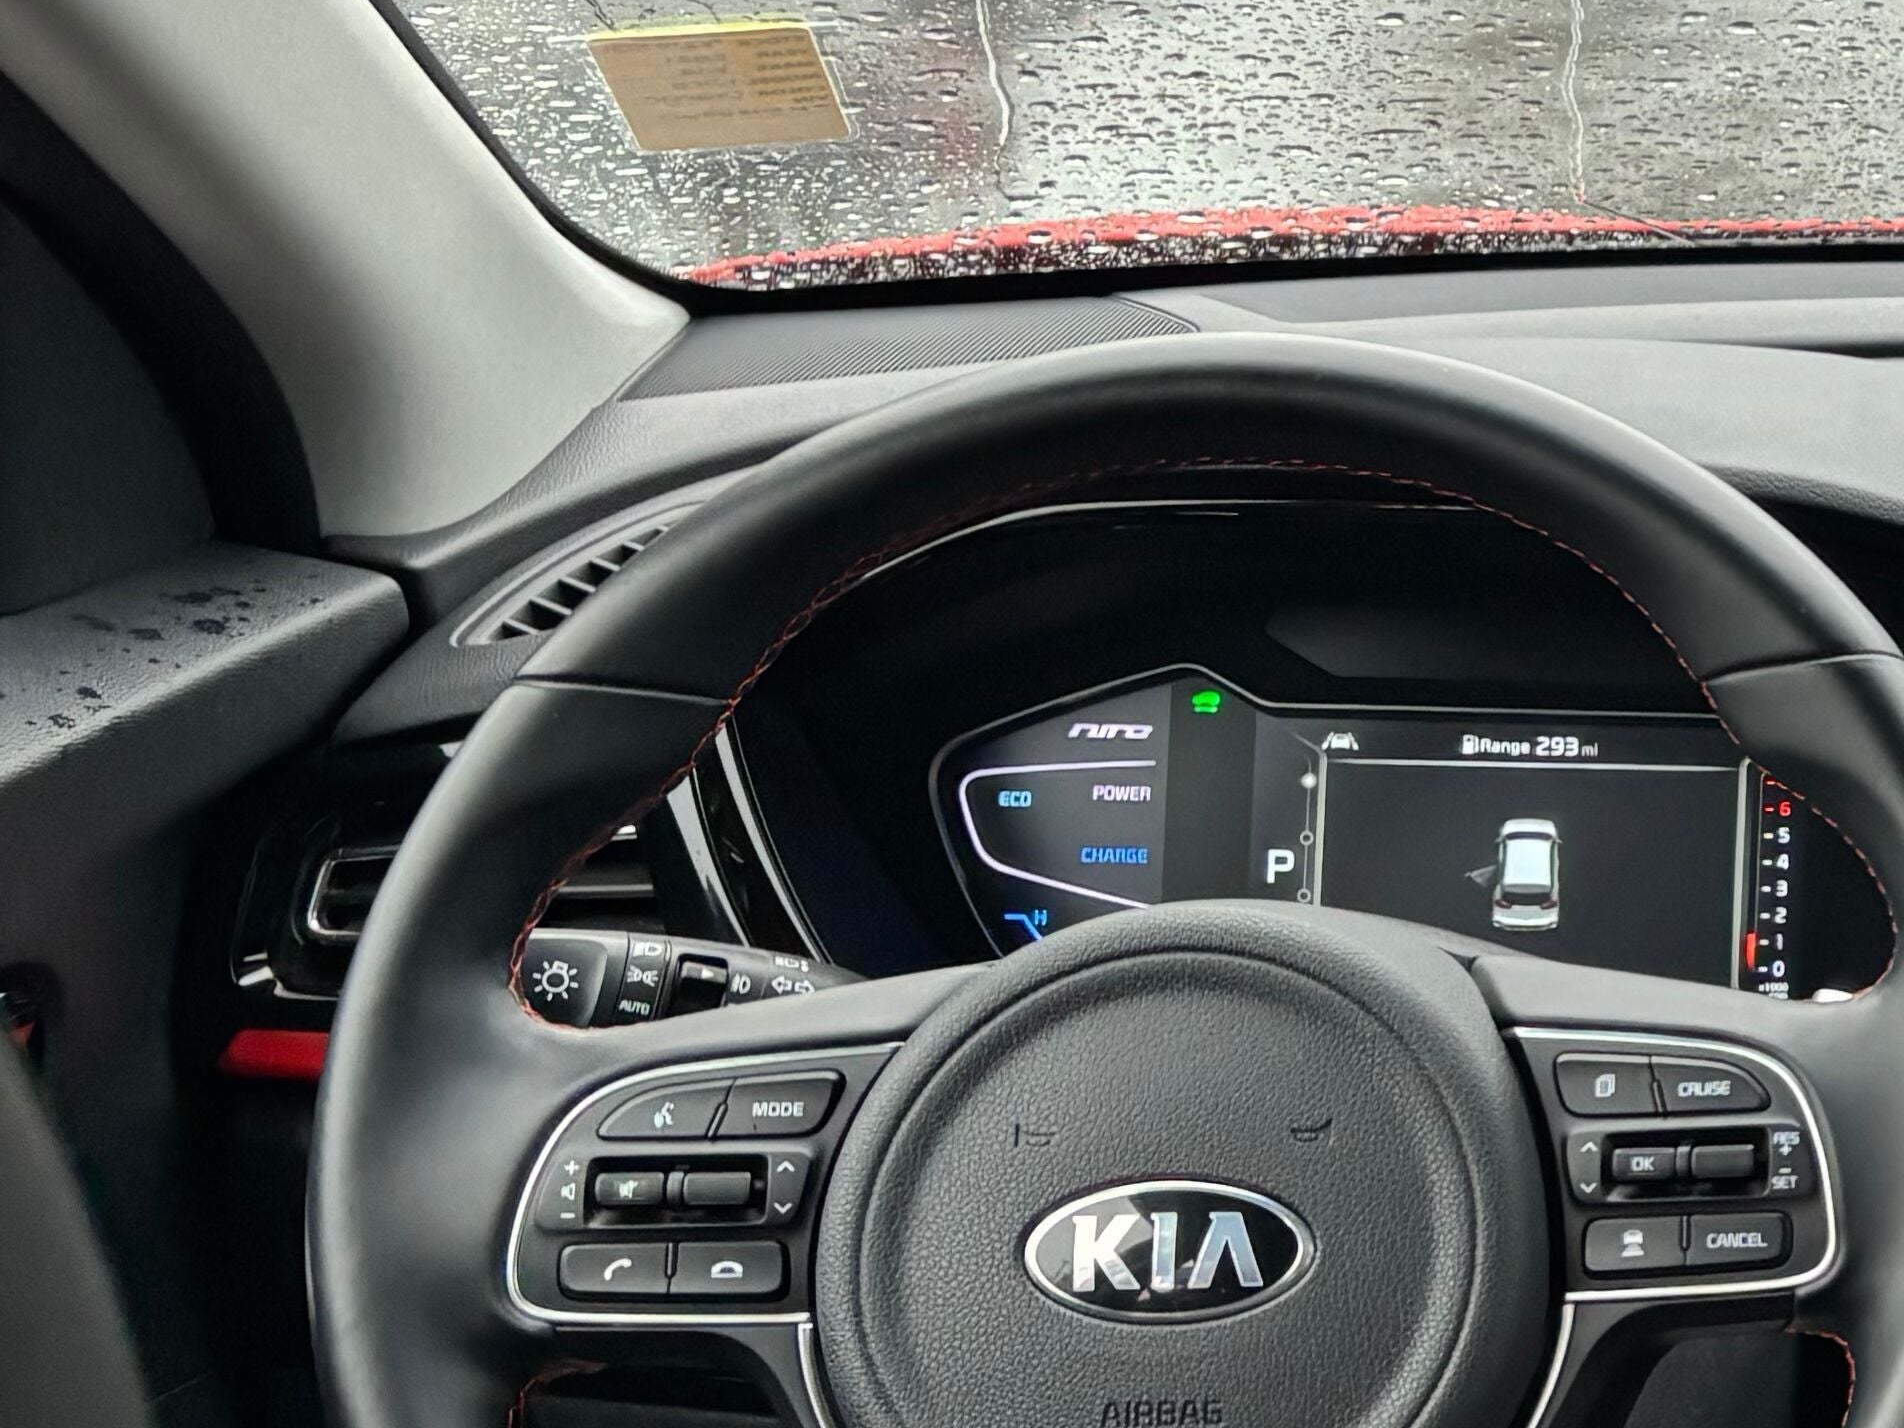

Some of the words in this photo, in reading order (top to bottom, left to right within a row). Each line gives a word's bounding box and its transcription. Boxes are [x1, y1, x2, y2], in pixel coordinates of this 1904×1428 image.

[1480, 736, 1531, 756] Range
[1535, 736, 1580, 757] 293
[998, 790, 1033, 807] ECO
[1092, 784, 1151, 802] POWER
[1778, 801, 1791, 817] 6
[1777, 827, 1791, 844] 5
[1080, 847, 1148, 864] CHARGE
[1776, 853, 1790, 870] 4
[1266, 848, 1296, 884] P
[1775, 879, 1788, 897] 3
[1774, 906, 1788, 924] 2
[1775, 933, 1784, 950] 1
[1772, 960, 1786, 977] 0
[619, 999, 650, 1016] AUTO
[1677, 1080, 1732, 1097] CRUISE
[752, 1101, 804, 1117] MODE
[1773, 1131, 1800, 1145] RES
[1631, 1156, 1655, 1172] OK
[1771, 1175, 1798, 1190] SET
[1706, 1231, 1768, 1249] CANCEL
[1072, 1211, 1264, 1292] KIA
